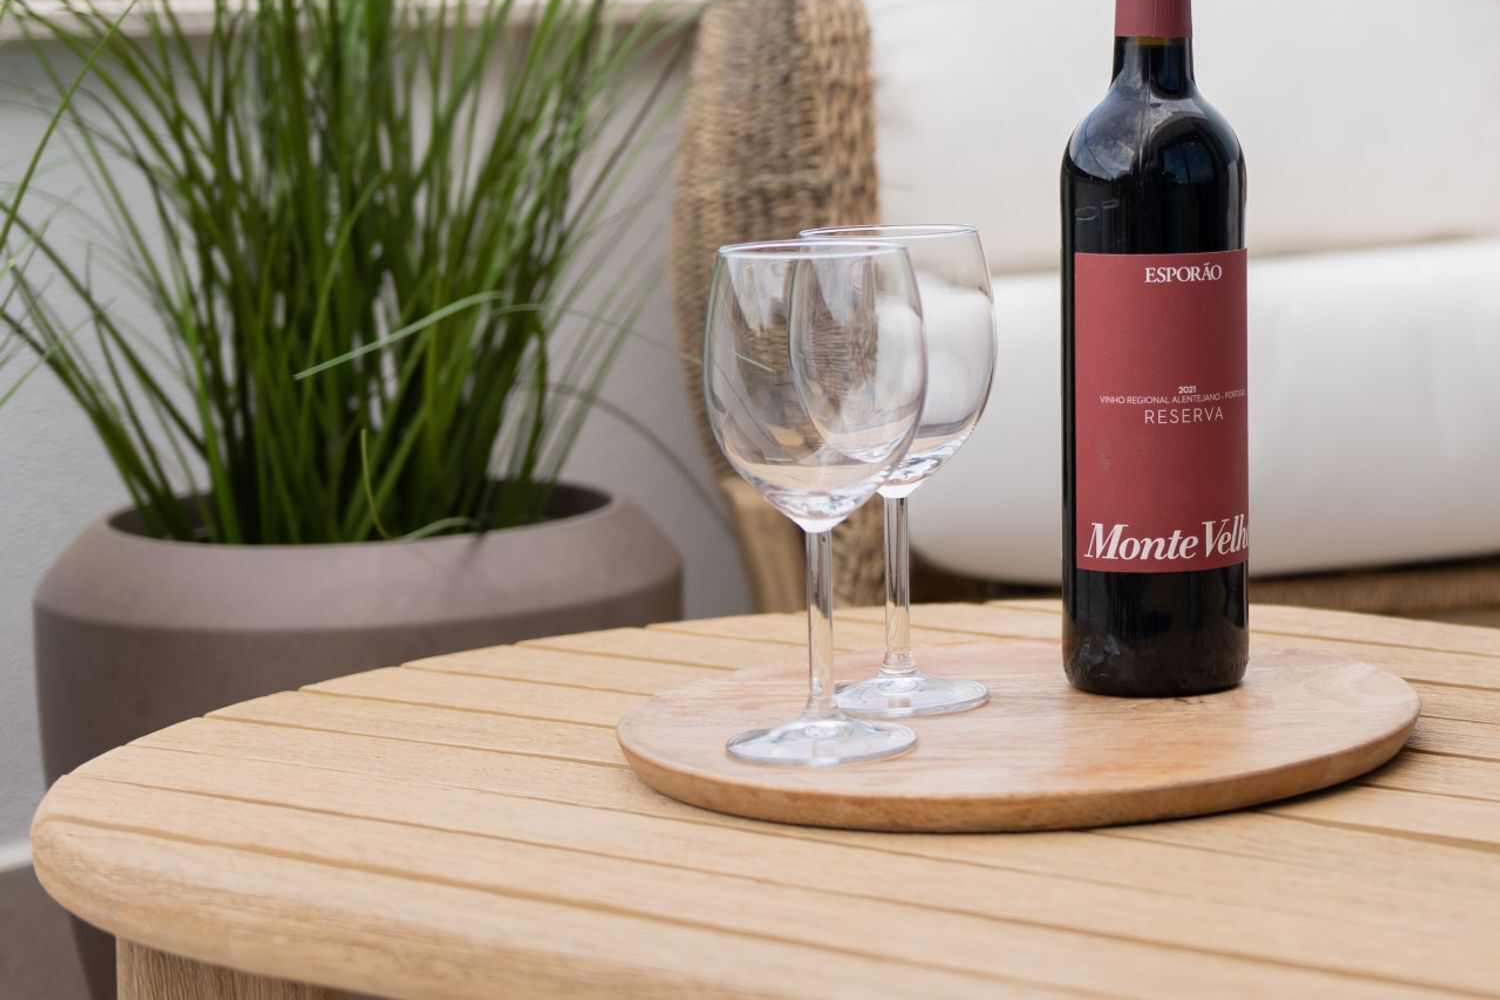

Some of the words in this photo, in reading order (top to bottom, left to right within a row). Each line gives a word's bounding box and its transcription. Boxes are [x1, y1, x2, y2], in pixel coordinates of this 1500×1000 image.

[1144, 262, 1222, 283] ESPORÃO
[1099, 395, 1125, 404] VINHO
[1126, 395, 1170, 404] REGIONAL
[1171, 392, 1220, 404] ALENTEJANO
[1178, 385, 1197, 394] 2021
[1144, 405, 1224, 424] RESERVA
[1083, 522, 1199, 561] Monte
